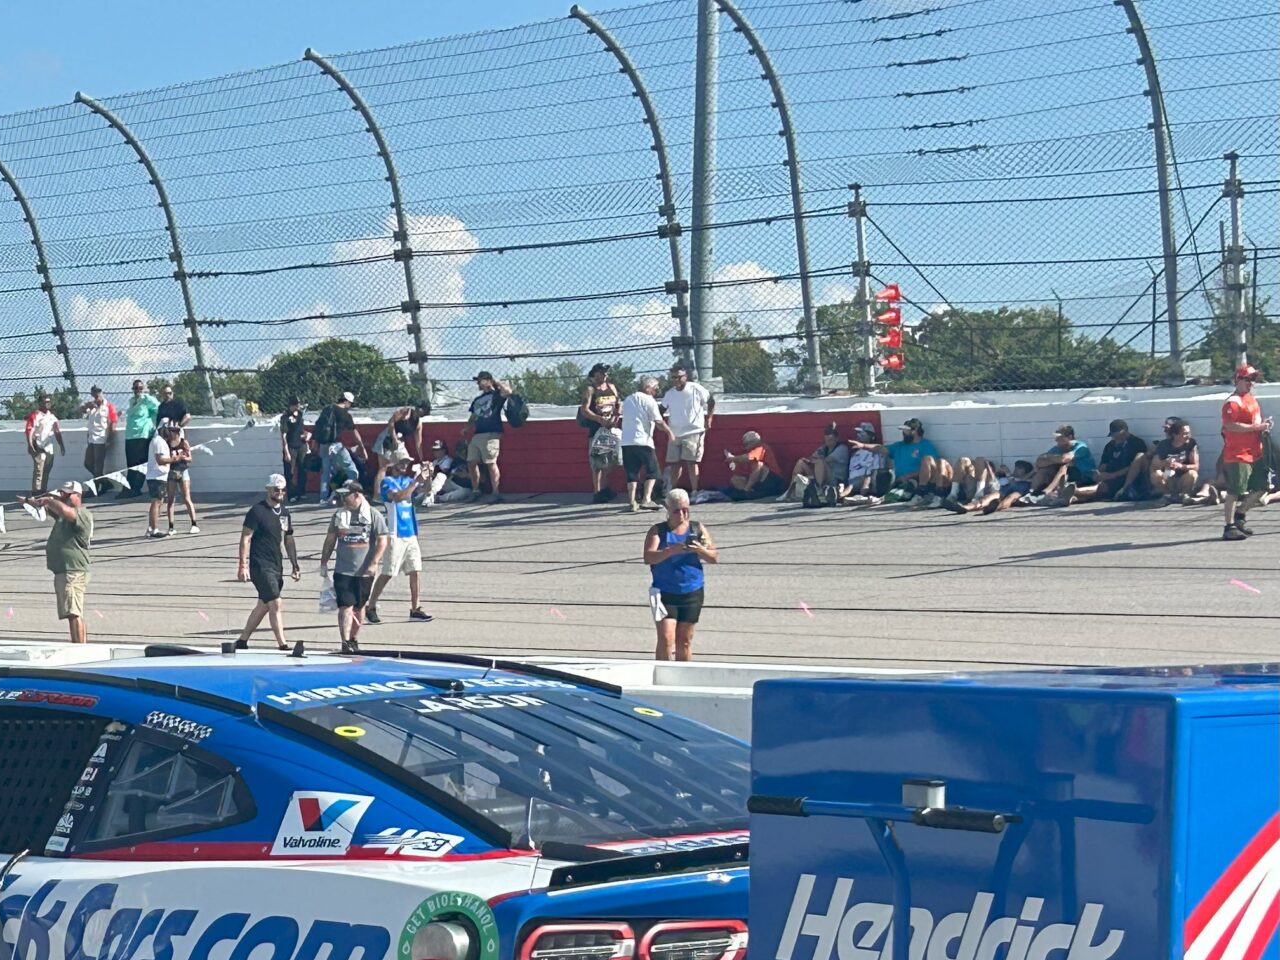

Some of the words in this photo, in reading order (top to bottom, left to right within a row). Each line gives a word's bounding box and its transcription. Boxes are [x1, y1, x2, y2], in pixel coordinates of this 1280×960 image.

[268, 680, 424, 705] HIRING
[283, 836, 342, 849] Valvoline
[406, 911, 425, 935] GET
[426, 892, 494, 935] BIOETHANOL
